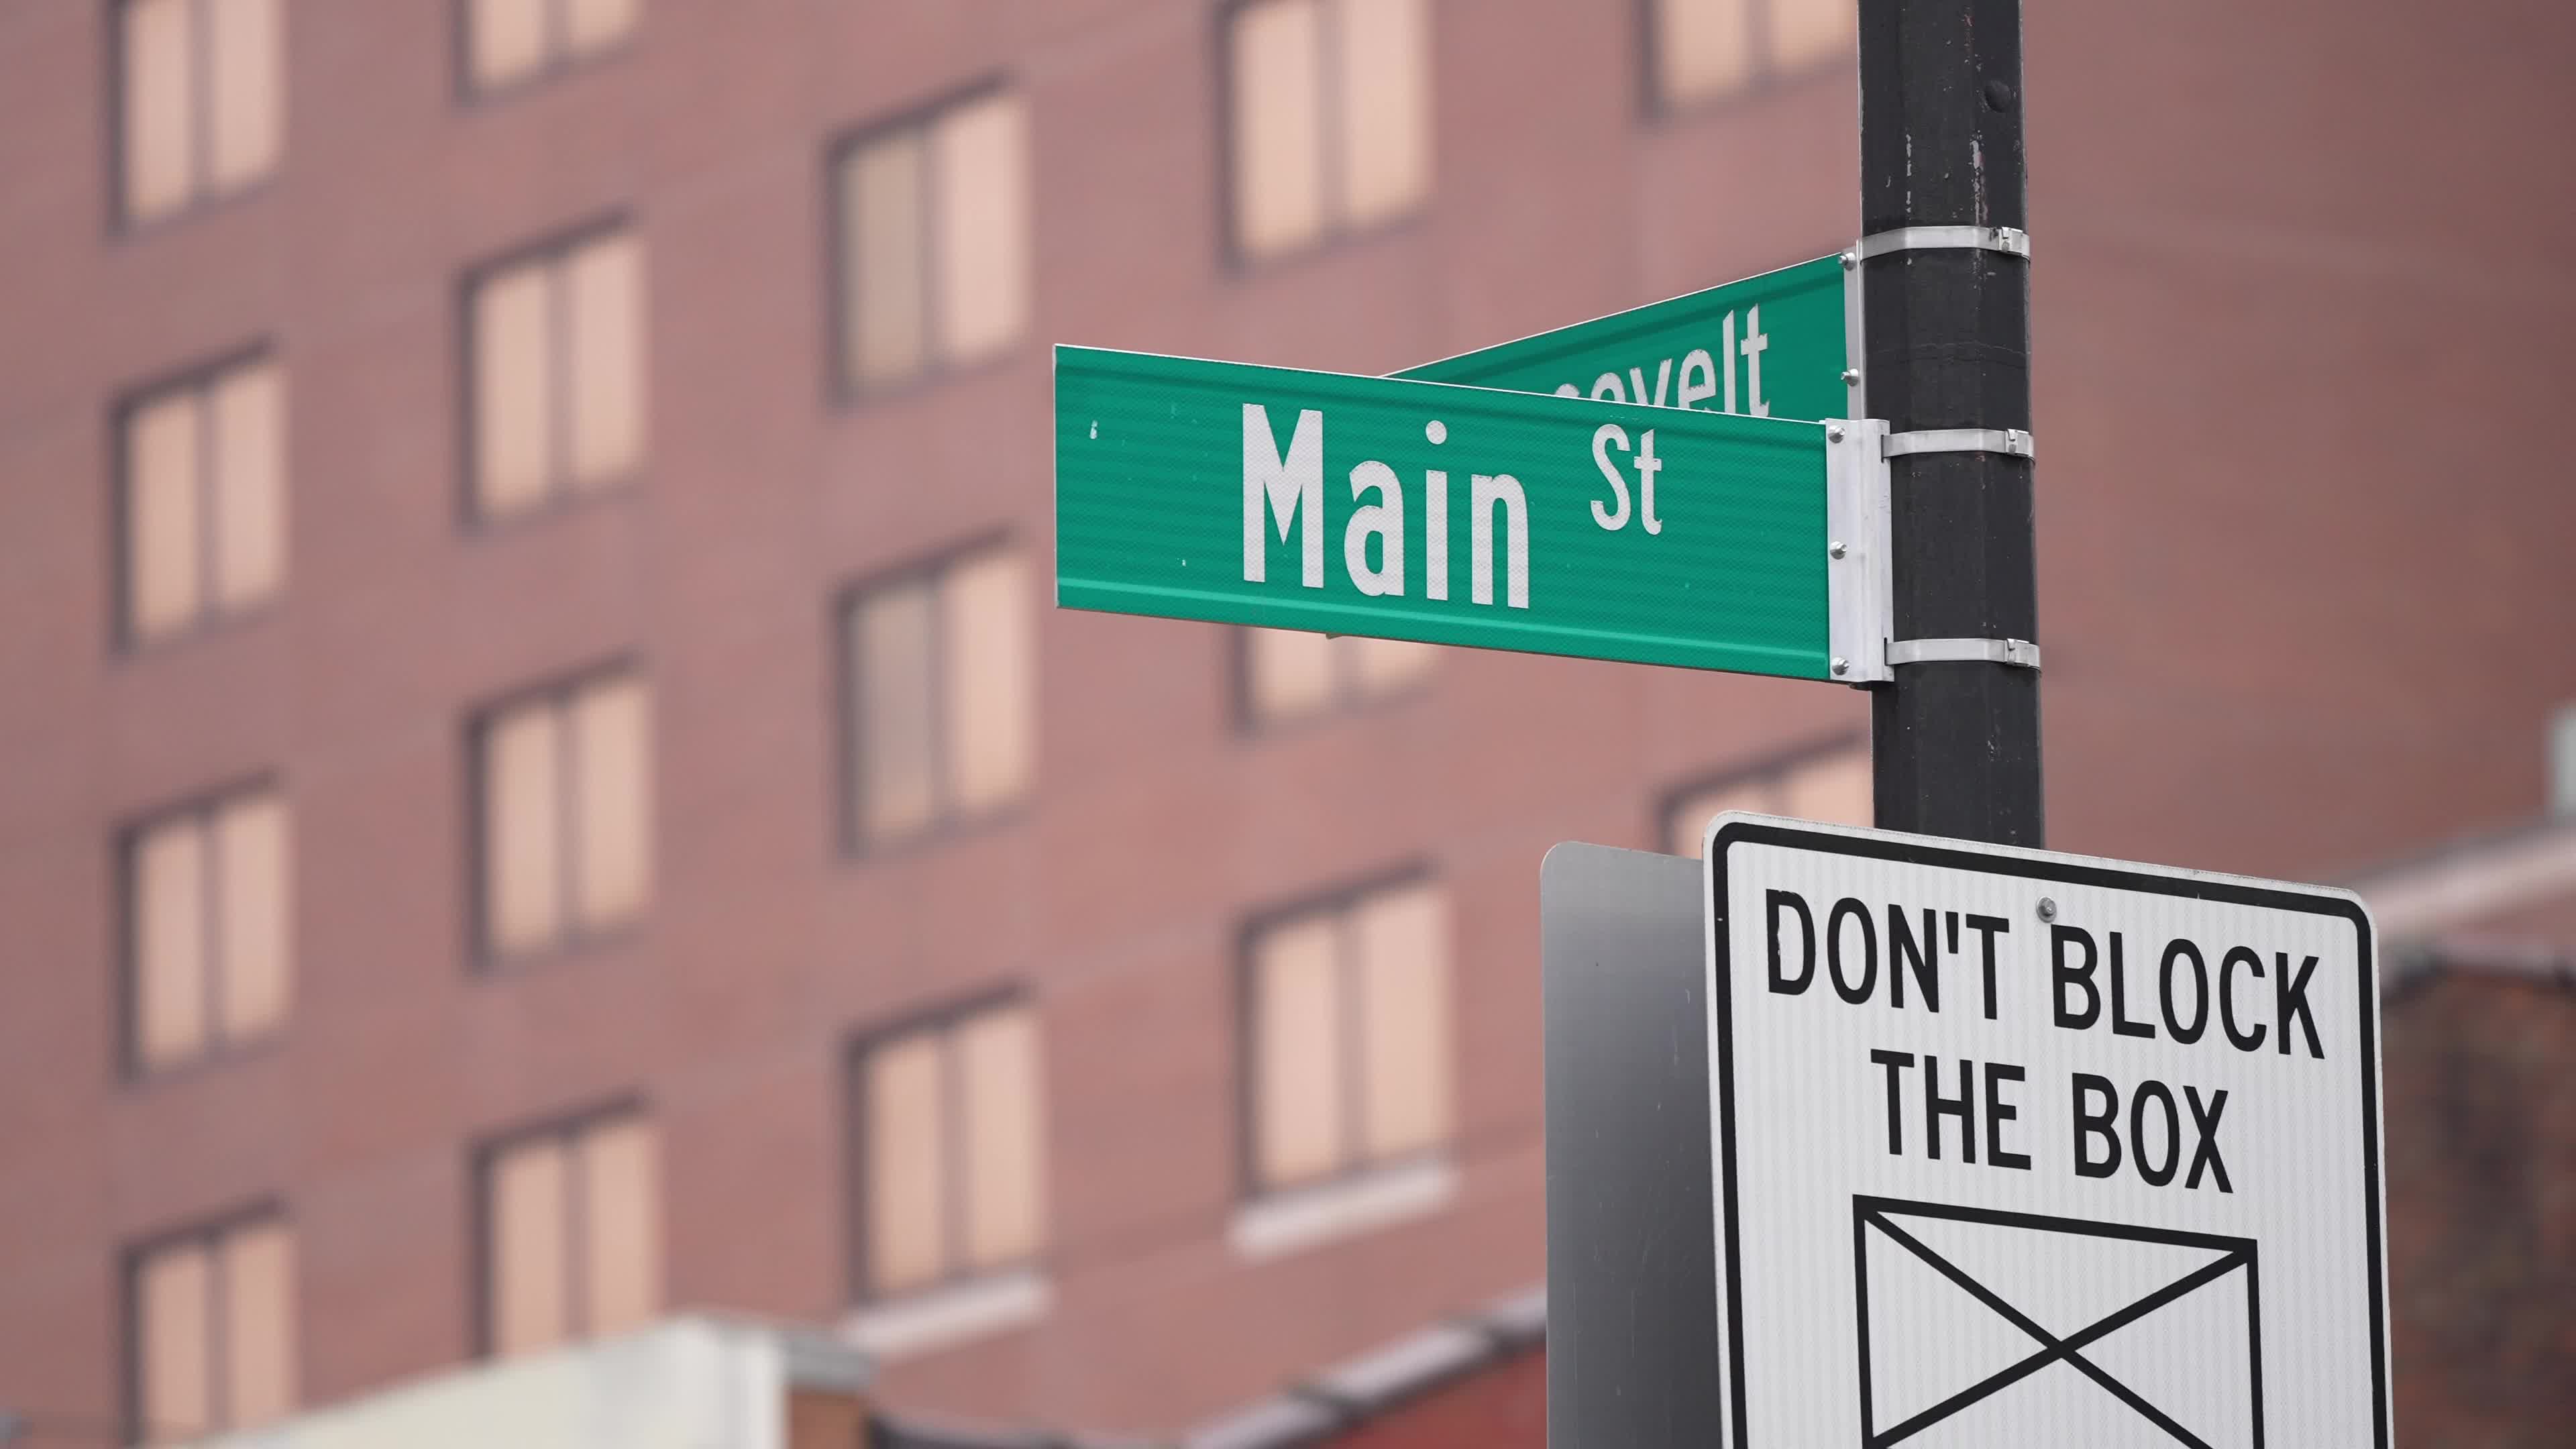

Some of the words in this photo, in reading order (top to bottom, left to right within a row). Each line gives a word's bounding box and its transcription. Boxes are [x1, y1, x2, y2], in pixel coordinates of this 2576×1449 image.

[1554, 303, 1770, 417] velt
[1242, 403, 1529, 609] Main
[1591, 423, 1662, 535] St
[1765, 888, 2010, 1020] DON'T
[2050, 924, 2325, 1060] BLOCK
[1870, 1049, 2031, 1171] THE
[2072, 1072, 2233, 1194] BOX
